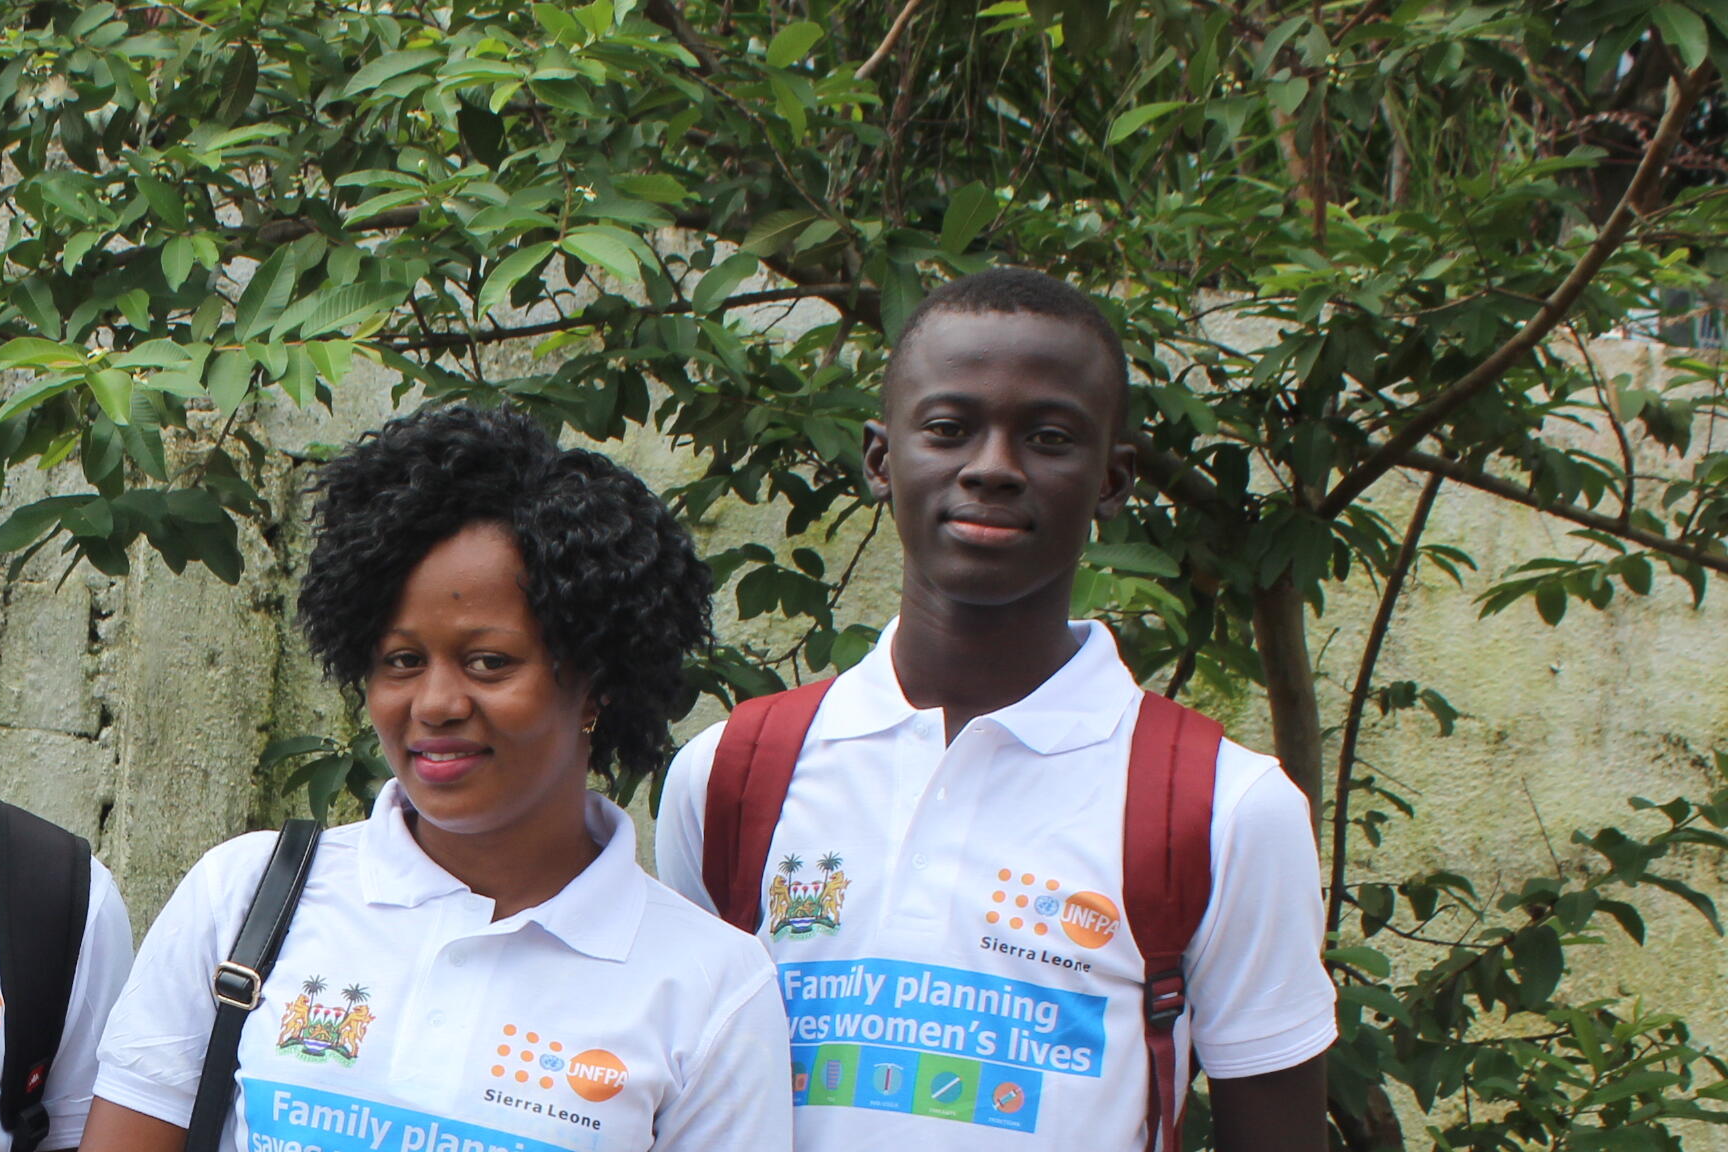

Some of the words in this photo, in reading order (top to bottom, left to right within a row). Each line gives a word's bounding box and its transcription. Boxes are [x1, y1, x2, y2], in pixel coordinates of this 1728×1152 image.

[1061, 902, 1120, 935] UNFPA
[980, 936, 1036, 961] Sierra
[1041, 950, 1091, 973] Leone
[784, 965, 886, 1005] Family
[894, 971, 1059, 1034] planning
[786, 1014, 830, 1041] ves
[835, 1012, 996, 1056] women's
[1008, 1026, 1091, 1072] lives
[567, 1060, 630, 1088] UNFPA
[272, 1090, 391, 1150] Family
[483, 1088, 542, 1114] Sierra
[547, 1104, 601, 1130] Leone
